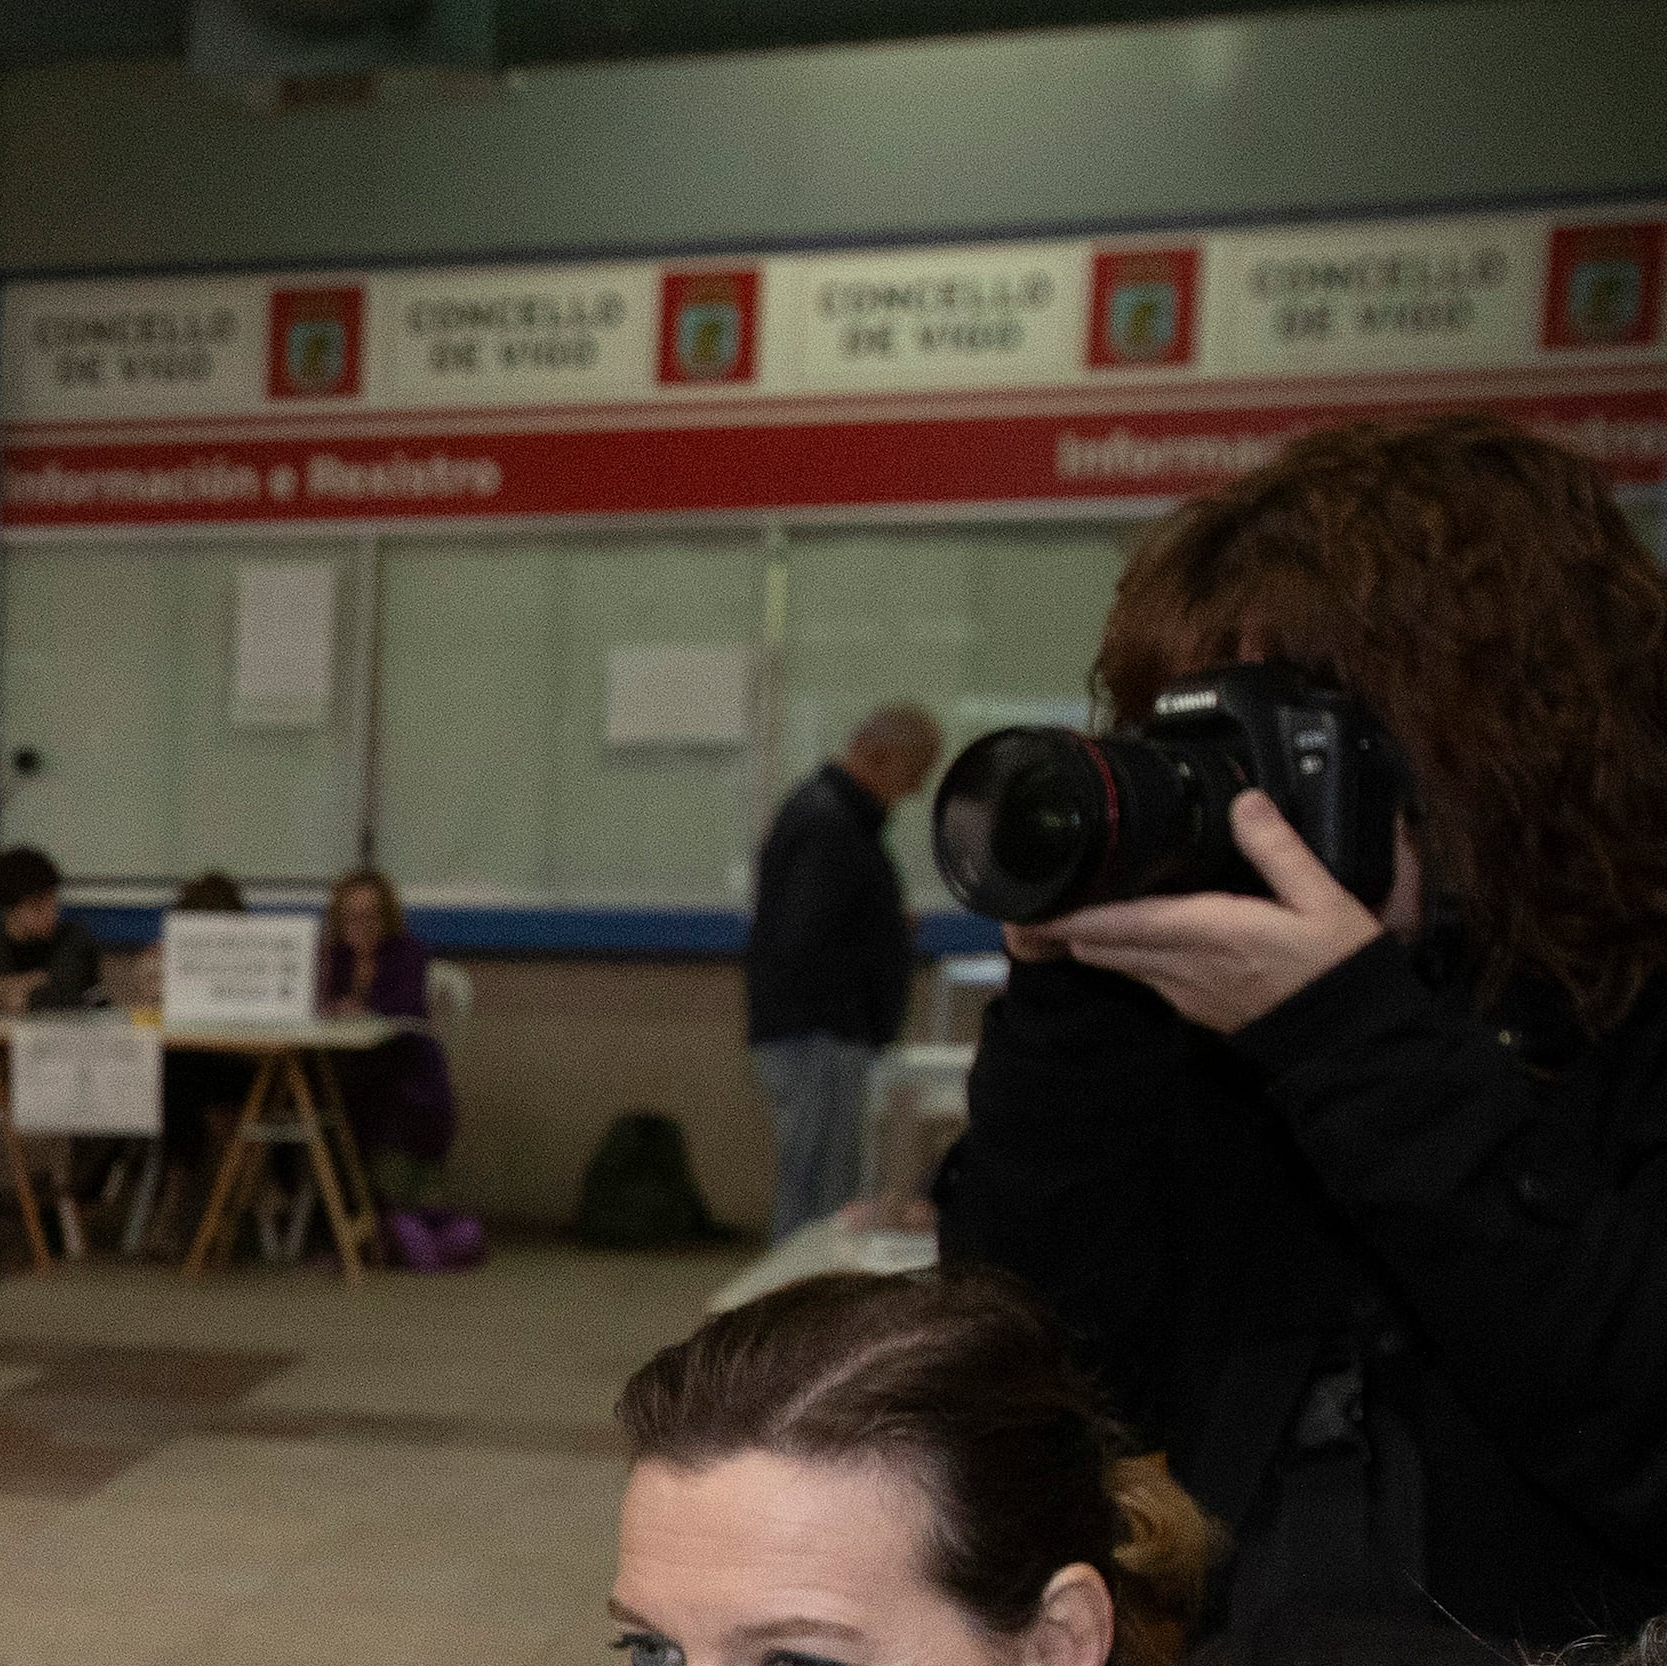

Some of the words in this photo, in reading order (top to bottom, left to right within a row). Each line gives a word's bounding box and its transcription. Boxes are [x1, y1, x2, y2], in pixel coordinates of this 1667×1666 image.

[1252, 247, 1509, 296] CONCELLO
[820, 270, 1055, 318] CONCELLO
[33, 308, 240, 349] CONCELLO
[409, 294, 625, 337] CONCELLO
[1279, 304, 1332, 340] DE
[430, 341, 479, 374] DE
[843, 322, 896, 358] DE
